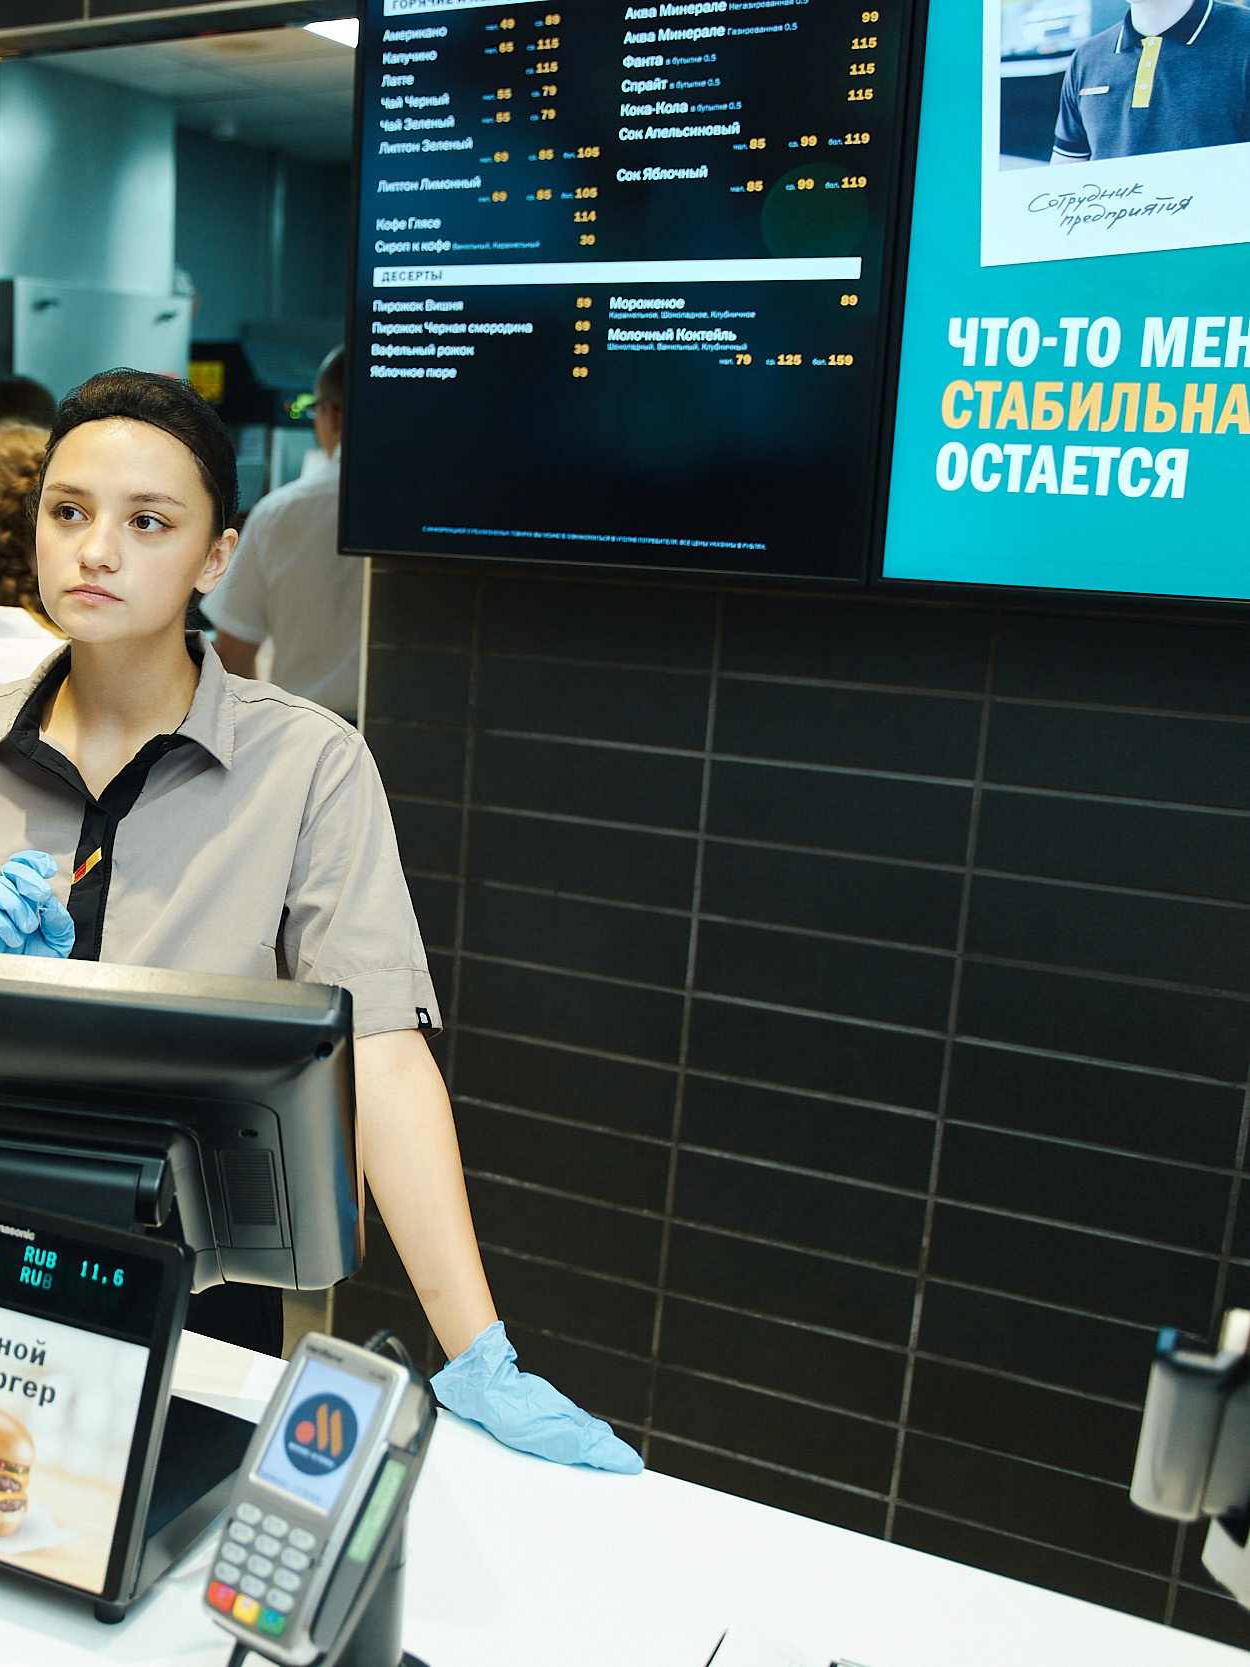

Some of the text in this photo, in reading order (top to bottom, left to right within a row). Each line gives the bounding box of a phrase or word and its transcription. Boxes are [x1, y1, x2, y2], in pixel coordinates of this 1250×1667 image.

[624, 6, 658, 21] Аква
[659, 0, 727, 18] Минерале
[861, 11, 879, 23] 99
[383, 25, 448, 42] Американо
[623, 21, 799, 45] Аква Минерале Газированная 0.5
[498, 41, 515, 54] 65
[536, 37, 560, 50] 115
[851, 36, 878, 50] 115
[382, 50, 438, 66] Капучино
[622, 53, 718, 69] Фанта в бутылке 0.5
[535, 61, 559, 74] 115
[849, 62, 876, 76] 115
[380, 74, 415, 88] Латте
[620, 76, 721, 94] Спрайт в бутылке 0.5
[496, 87, 512, 100] 55
[541, 84, 558, 97] 79
[847, 88, 874, 101] 115
[380, 92, 450, 110] Чай Черный
[540, 108, 556, 121] 79
[620, 100, 743, 117] Кока-Кола в бутылке 0.5
[379, 115, 456, 132] Чай Зеленый
[495, 111, 511, 124] 55
[618, 120, 741, 141] Сок Апельсиновый
[749, 137, 766, 150] 85
[800, 134, 818, 147] 99
[844, 132, 871, 145] 119
[378, 136, 474, 155] Липтон Зеленый
[493, 151, 510, 163] 69
[576, 146, 600, 159] 105
[616, 164, 708, 182] Сок Яблочный
[377, 175, 482, 193] Липтон Лимонный
[746, 180, 763, 192] 85
[797, 178, 815, 190] 99
[841, 175, 867, 189] 119
[491, 190, 508, 202] 69
[574, 187, 598, 199] 105
[1028, 183, 1144, 216] Сотрудник
[573, 210, 597, 222] 114
[1059, 195, 1193, 236] предприятия
[376, 217, 442, 232] Кофе Глясе
[579, 233, 596, 246] 30
[375, 240, 411, 255] Сироп
[412, 241, 421, 251] к
[421, 238, 451, 253] кофе
[381, 271, 443, 283] ДЕСЕРТЫ
[372, 299, 464, 314] Пирожок Вишня
[576, 296, 593, 309] 59
[609, 296, 686, 311] Мороженое
[840, 294, 858, 306] 89
[710, 309, 756, 320] Клубничное
[371, 321, 534, 336] Пирожок Черная смородина
[574, 320, 591, 332] 69
[607, 327, 737, 342] Молочный Коктейль
[948, 316, 1122, 368] ЧТО-ТО
[370, 343, 475, 358] Вафельный рожок
[573, 343, 590, 355] 39
[735, 353, 752, 366] 79
[777, 353, 802, 366] 125
[828, 354, 854, 366] 159
[370, 365, 457, 381] Яблочное пюре
[572, 366, 589, 379] 69
[935, 441, 1190, 499] ОСТАЕТСЯ
[23, 1245, 58, 1270] RUB
